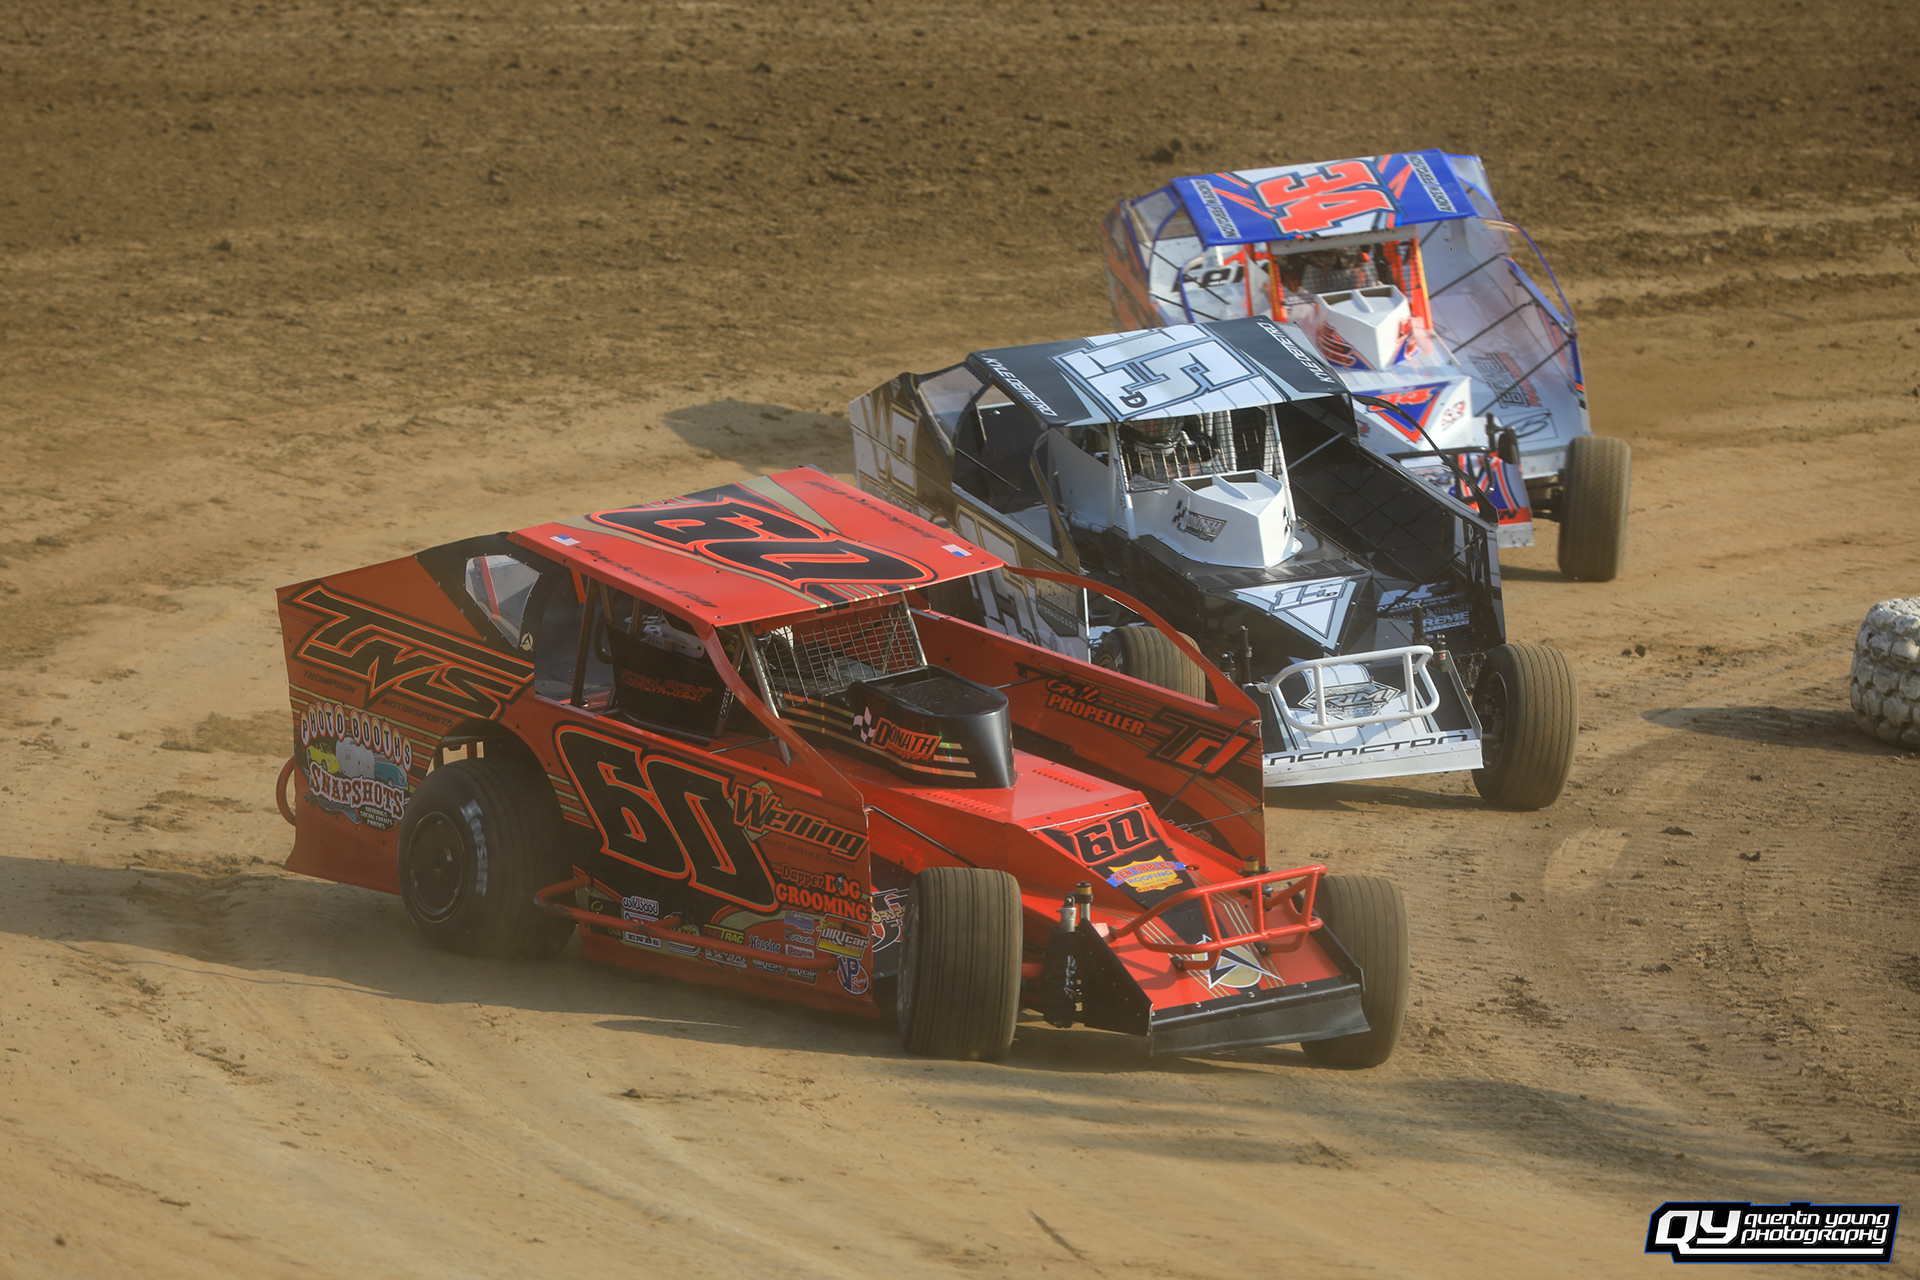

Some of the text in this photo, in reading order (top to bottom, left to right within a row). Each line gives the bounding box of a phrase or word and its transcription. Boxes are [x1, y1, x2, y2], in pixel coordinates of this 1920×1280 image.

[1256, 160, 1398, 235] 34
[1257, 322, 1307, 361] DEMETRO
[983, 357, 1058, 417] KYLE DEMETRO
[1301, 359, 1336, 384] KYLE
[584, 498, 938, 587] 60
[303, 669, 453, 727] THOMPSON MOTORSPORTS
[1048, 694, 1145, 736] PROPELLER
[302, 705, 412, 769] PHOTO BOOTHS
[873, 718, 940, 756] DONATH
[309, 762, 405, 820] SNAPSHOTS
[555, 724, 779, 912] 60
[732, 784, 870, 861] Welling
[1073, 809, 1152, 863] 60
[762, 837, 785, 850] AUTO
[786, 843, 823, 861] SERVICE
[781, 863, 825, 889] Dapper
[1114, 861, 1176, 881] KEN TIBBLES
[1127, 869, 1174, 884] ROOFING
[775, 883, 869, 922] GROOMING
[821, 928, 870, 949] DIRTcar
[838, 955, 860, 993] VP
